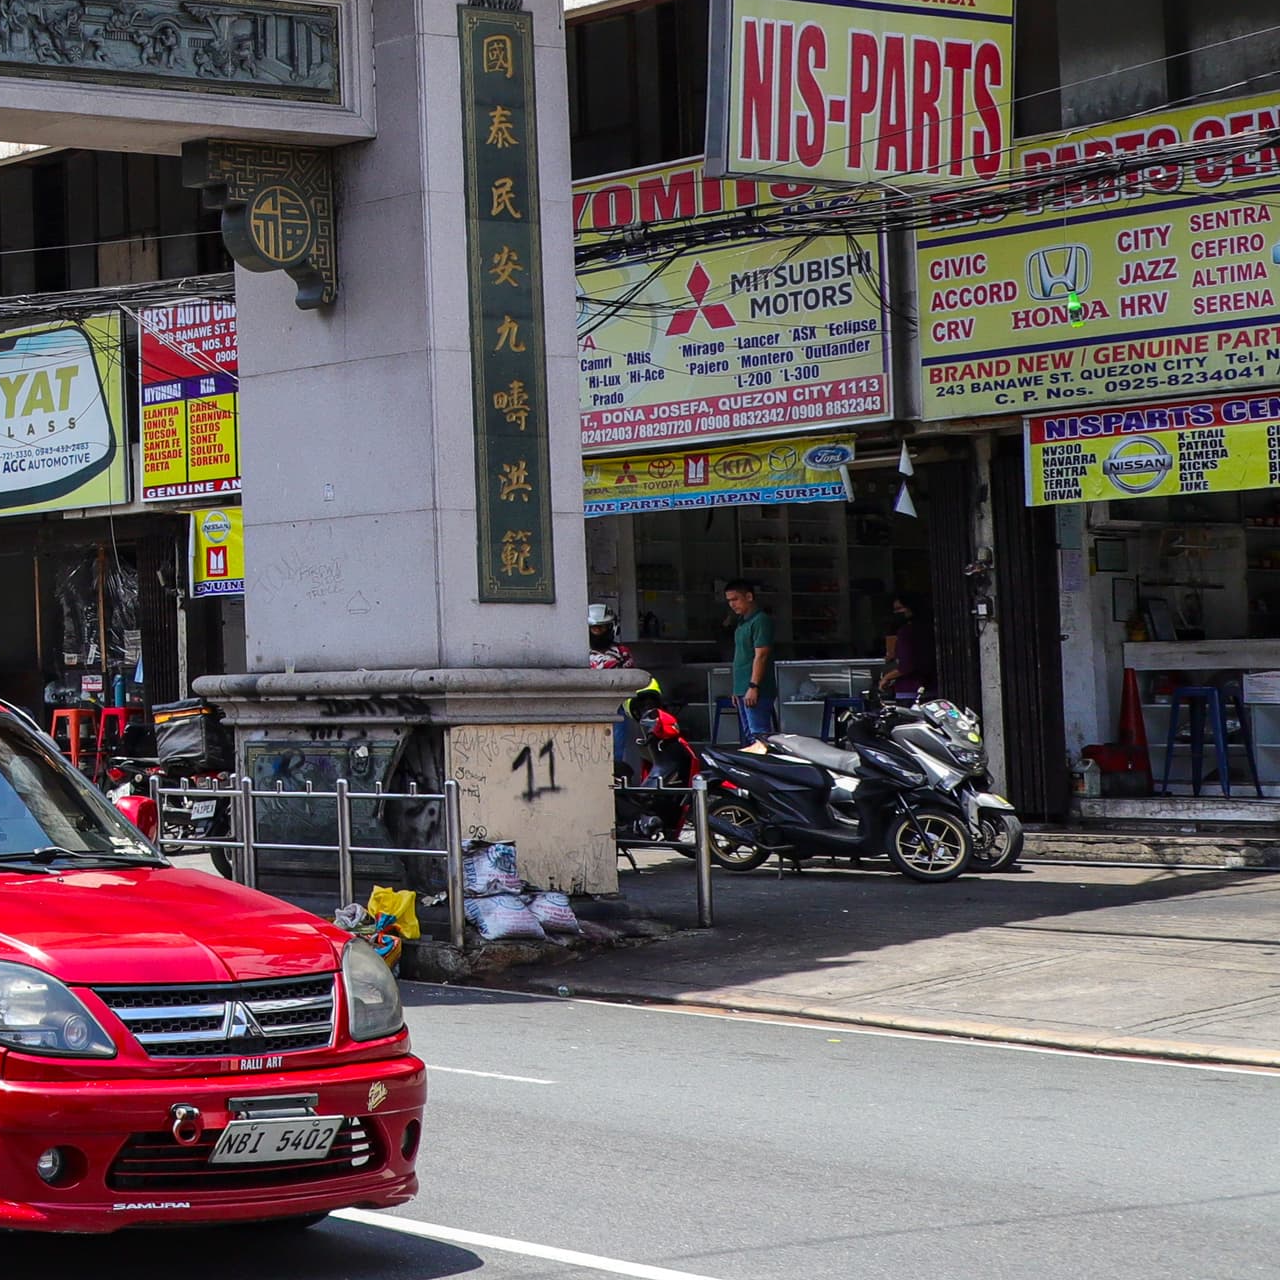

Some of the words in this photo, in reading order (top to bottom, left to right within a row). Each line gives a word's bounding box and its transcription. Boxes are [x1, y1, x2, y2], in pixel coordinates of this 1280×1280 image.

[739, 17, 1005, 181] NIS-PARTS
[1189, 204, 1273, 233] SENTRA
[1117, 225, 1172, 253] CITY
[1190, 233, 1266, 261] CEFIRO
[730, 251, 871, 296] MITSUBISHI
[929, 254, 987, 281] CIVIC
[1118, 257, 1178, 286] JAZZ
[1191, 261, 1269, 288] ALTIMA
[750, 282, 853, 320] MOTORS
[930, 280, 1018, 312] ACCORD
[1120, 292, 1169, 318] HRV
[1193, 289, 1275, 316] SERENA
[681, 340, 725, 358] Mirage
[736, 331, 781, 350] Lancer
[792, 325, 817, 342] ASX
[828, 317, 877, 337] Eclipse
[931, 318, 975, 343] CRV
[201, 338, 223, 351] NOS.
[579, 354, 613, 372] Camri
[625, 351, 652, 366] Altis
[688, 359, 730, 377] Pajero
[740, 351, 794, 370] Montero
[804, 339, 871, 361] Outlander
[929, 357, 1011, 385] BRAND
[1017, 351, 1074, 374] NEW
[1093, 333, 1209, 366] GENUINE
[588, 373, 622, 390] Hi-Lux
[629, 369, 665, 384] Hi-Ace
[736, 372, 772, 388] L-200
[783, 364, 820, 382] L-300
[935, 384, 966, 399] 243
[969, 375, 1043, 395] BANAWE
[1047, 370, 1076, 387] ST.
[1080, 362, 1158, 382] QUEZON
[1163, 356, 1208, 371] CITY
[1225, 350, 1260, 365] Tel.
[144, 383, 182, 403] HYUNDAI
[199, 377, 216, 395] KIA
[994, 391, 1016, 406] C.
[1022, 387, 1040, 402] P.
[1045, 384, 1095, 400] Nos.
[1104, 365, 1266, 394] 0925-8234041
[592, 391, 625, 407] Prado
[602, 407, 646, 424] DOÑA
[649, 400, 715, 421] JOSEFA,
[718, 389, 788, 410] QUEZON
[792, 383, 832, 402] CITY
[838, 377, 880, 395] 1113
[143, 406, 180, 420] ELANTRA
[190, 410, 232, 425] CARNIVAL
[1043, 403, 1214, 441] NISPARTS
[143, 428, 177, 441] TUCSON
[190, 422, 221, 435] SELTOS
[1177, 428, 1227, 442] X-TRAIL
[144, 440, 170, 452] SANTA
[171, 438, 181, 449] FE
[190, 433, 218, 446] SONET
[1178, 439, 1226, 452] PATROL
[144, 447, 183, 463] PALISADE
[190, 443, 224, 457] SOLUTO
[1042, 443, 1082, 457] NV300
[1178, 448, 1230, 462] ALMERA
[2, 459, 27, 475] AGC
[28, 452, 91, 471] AUTOMOTIVE
[144, 460, 170, 473] CRETA
[190, 454, 231, 468] SORENTO
[1042, 453, 1098, 469] NAVARRA
[1109, 457, 1167, 472] NISSAN
[1178, 459, 1219, 472] KICKS
[1043, 465, 1088, 480] SENTRA
[1179, 471, 1205, 482] GTR
[146, 481, 215, 499] GENUINE
[642, 479, 680, 490] TOYOTA
[1043, 477, 1080, 491] TERRA
[1178, 480, 1210, 493] JUKE
[619, 498, 670, 511] PARTS
[673, 495, 706, 509] and
[710, 490, 761, 506] JAPAN
[1043, 487, 1082, 502] URVAN
[240, 1057, 263, 1071] RALLI
[265, 1056, 283, 1069] ART
[219, 1131, 266, 1155] NBI
[275, 1127, 334, 1153] 5402
[112, 1201, 191, 1211] SAMURAI
